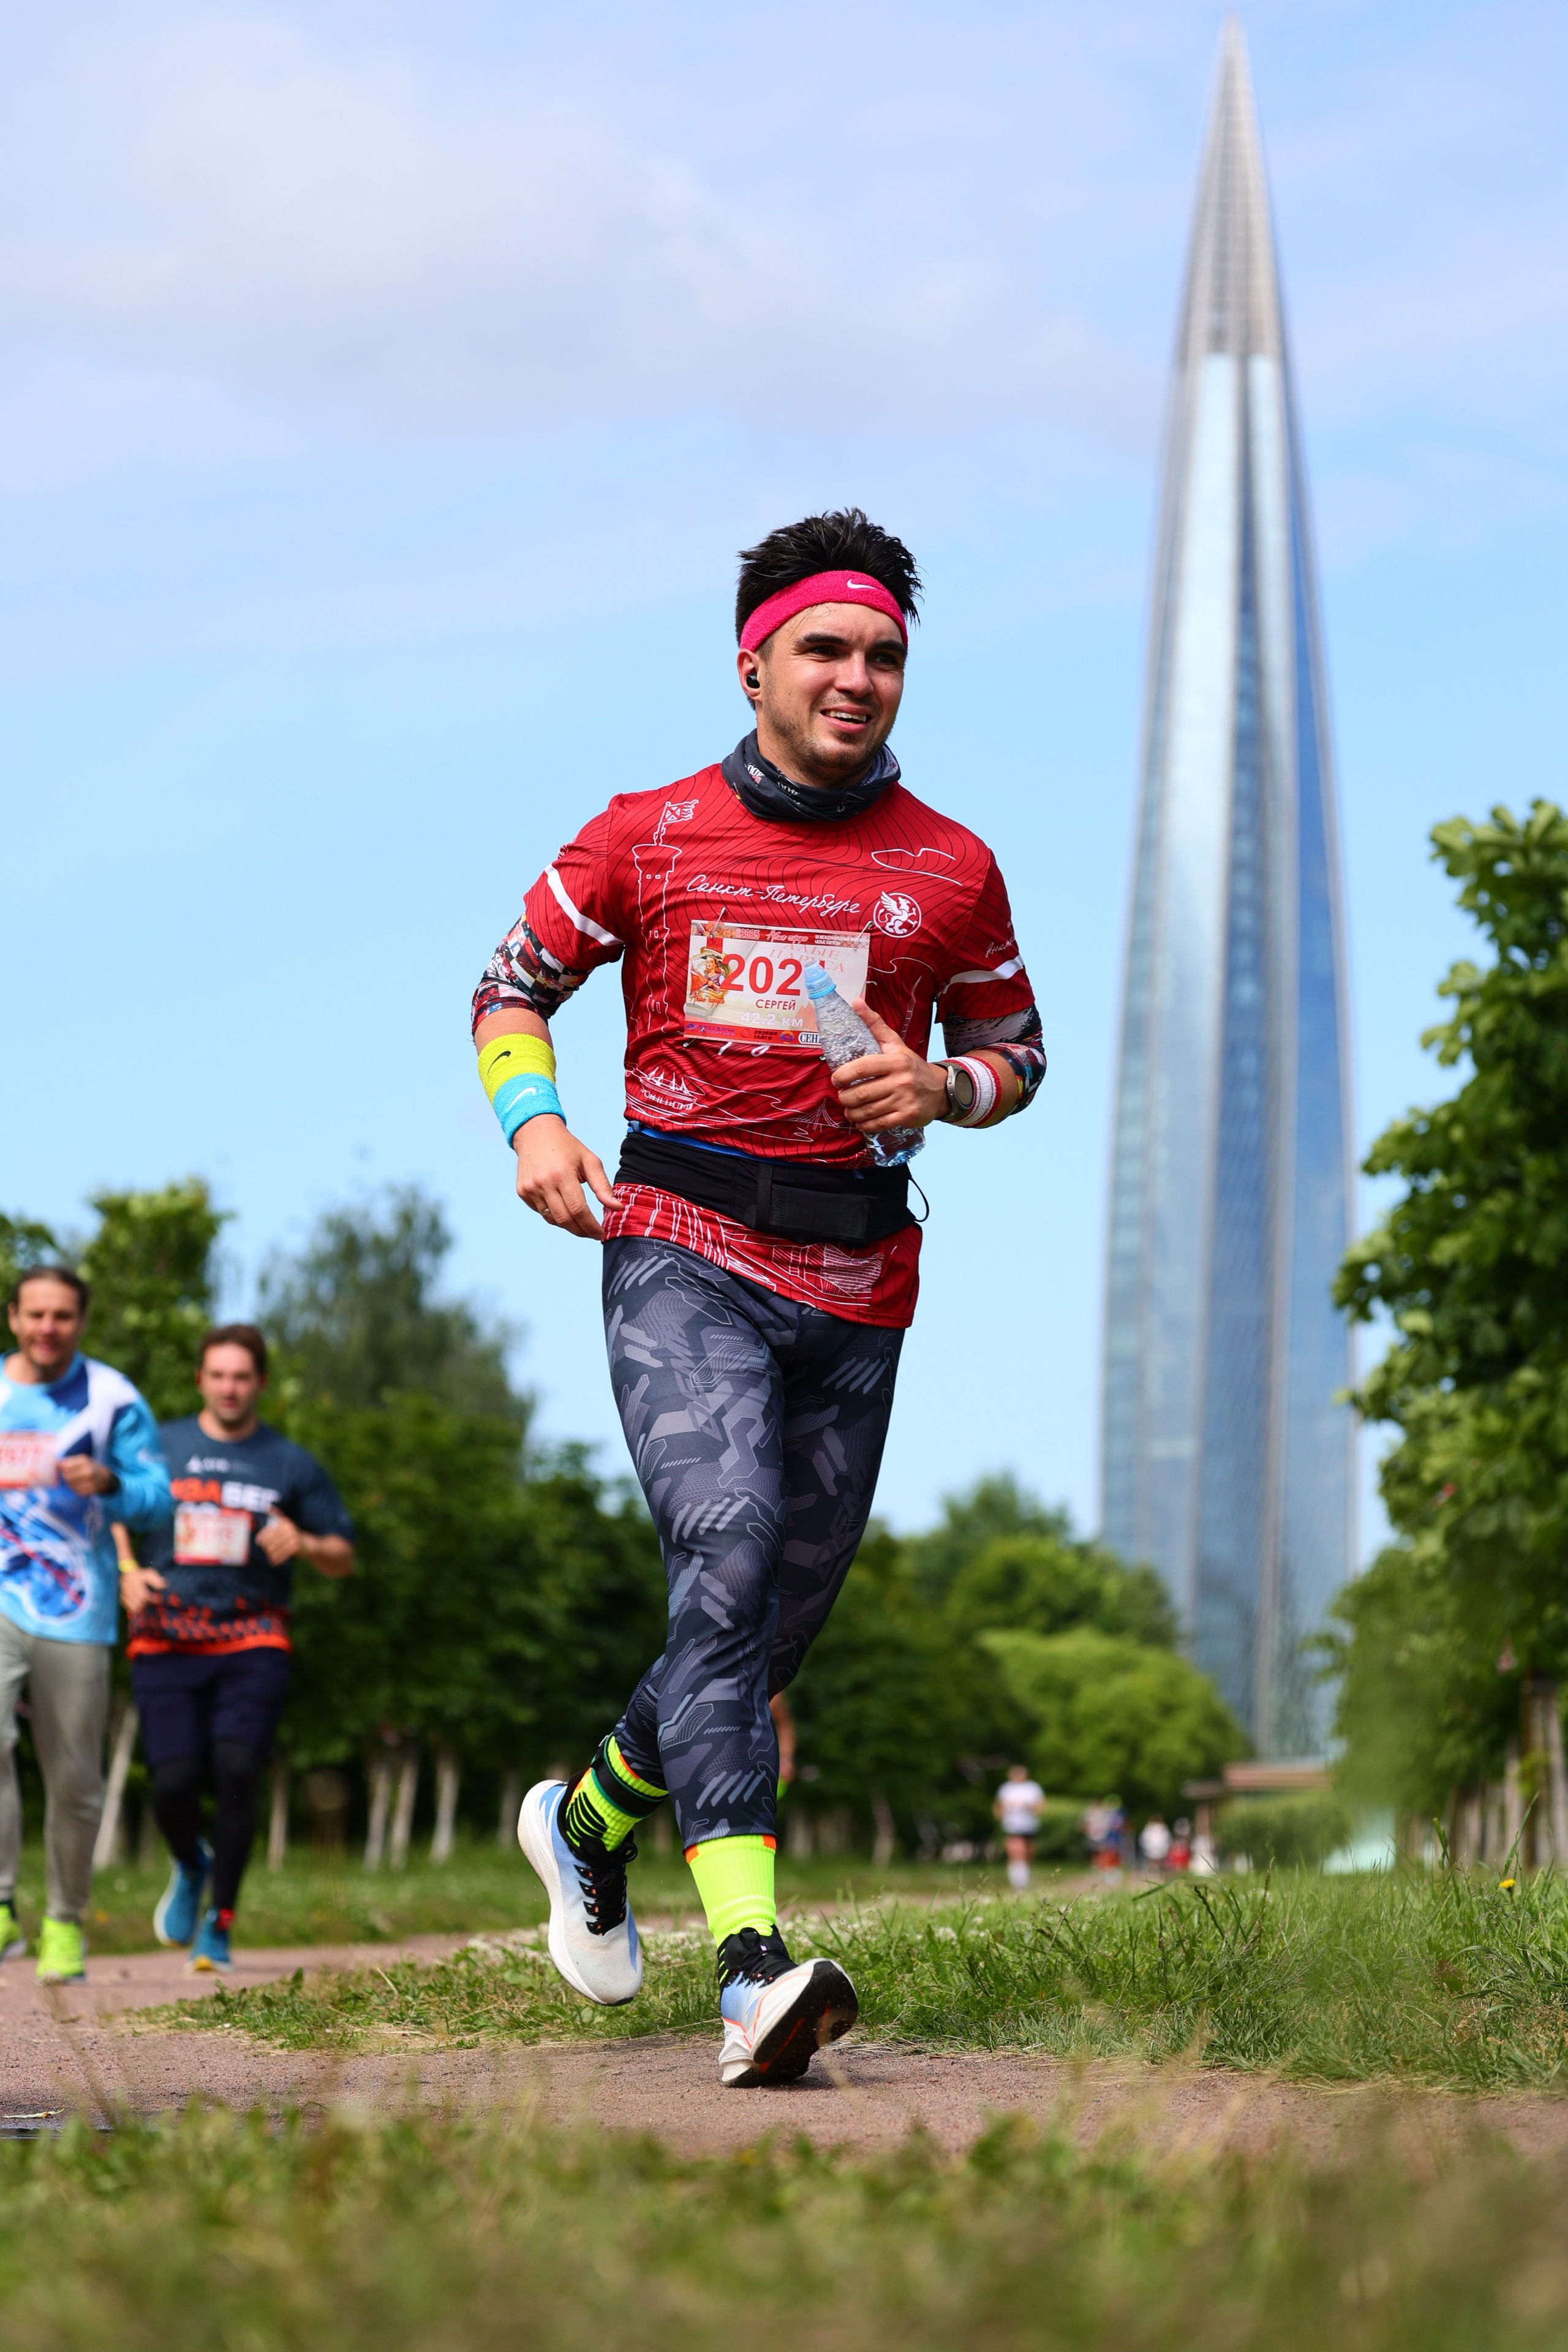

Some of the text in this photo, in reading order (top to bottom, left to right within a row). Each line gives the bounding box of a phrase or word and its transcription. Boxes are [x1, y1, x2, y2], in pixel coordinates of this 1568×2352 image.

[687, 874, 861, 918] Санкт-Петербург
[720, 954, 825, 997] 202
[755, 999, 797, 1011] СЕРГЕЙ
[740, 1011, 776, 1026] 42.2
[800, 1033, 821, 1044] СЕН
